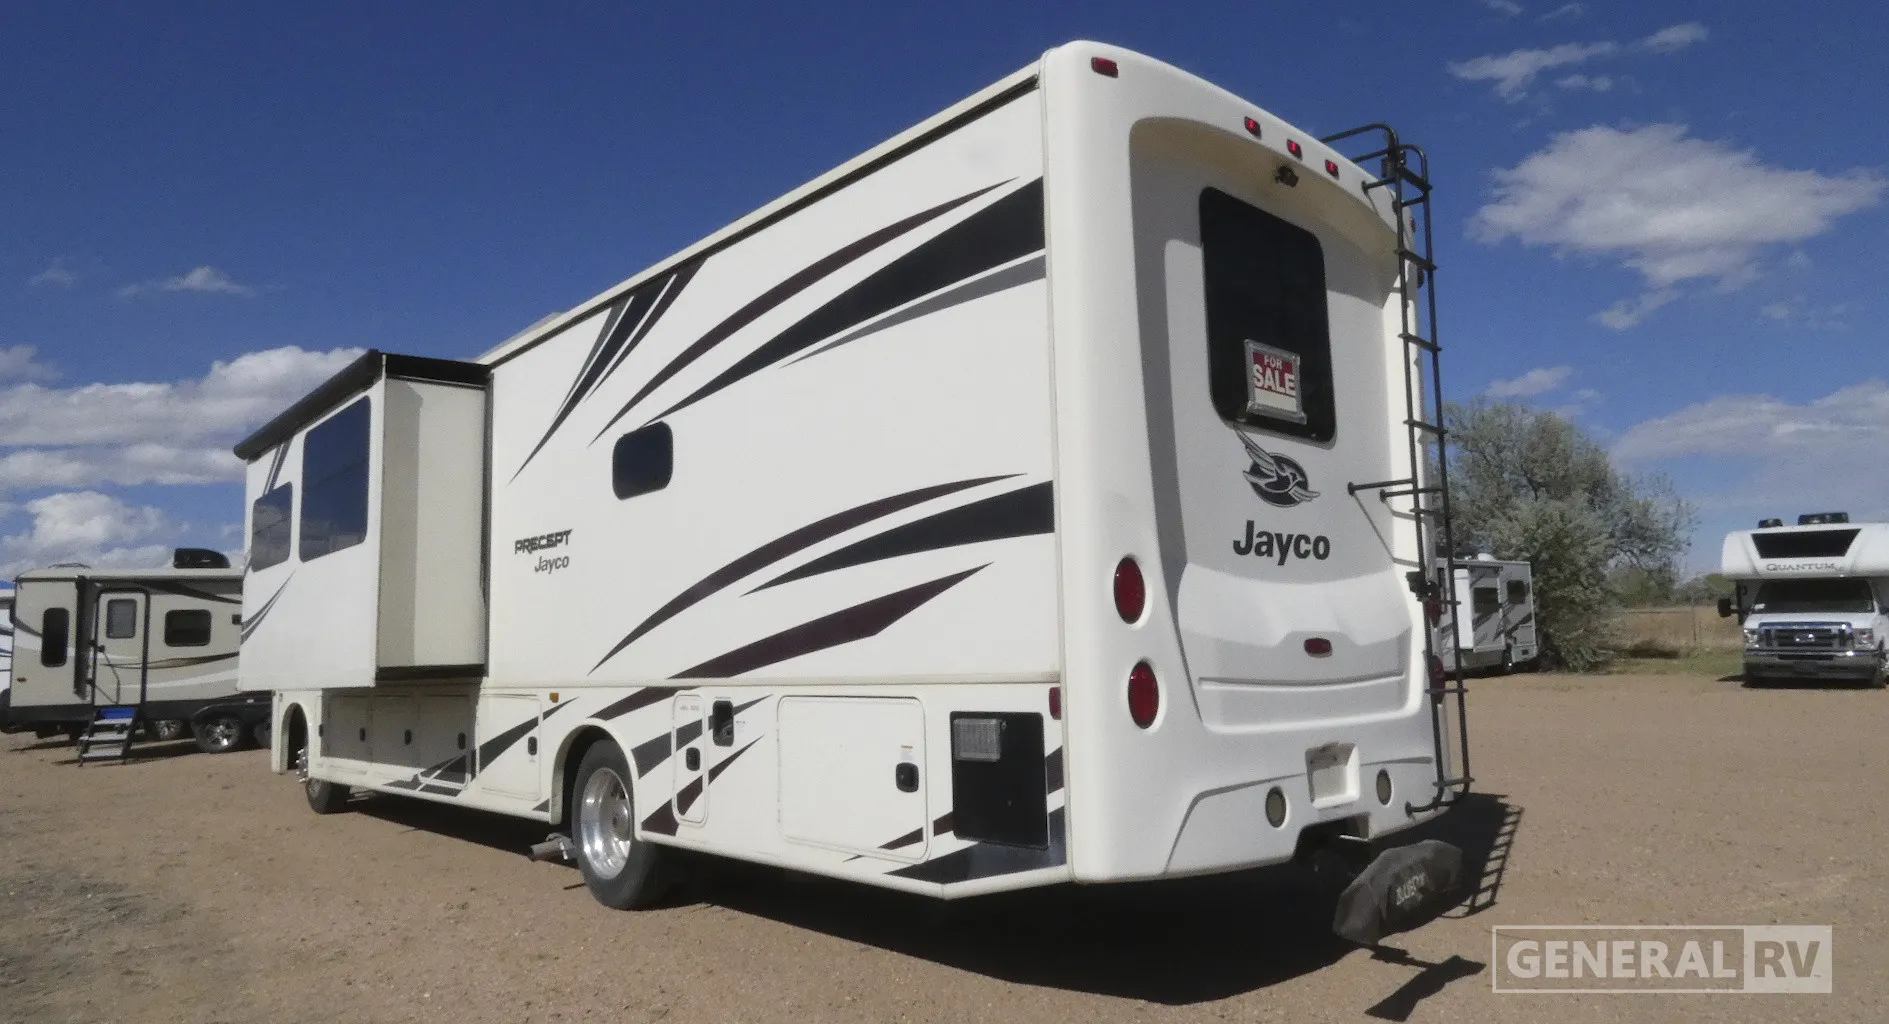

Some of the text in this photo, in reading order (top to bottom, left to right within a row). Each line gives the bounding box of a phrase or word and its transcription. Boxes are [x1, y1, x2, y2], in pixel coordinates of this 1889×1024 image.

[1264, 355, 1283, 370] FOR
[1253, 363, 1296, 397] SALE
[514, 529, 573, 555] PRECEPT
[1233, 520, 1330, 566] Jayco
[534, 556, 570, 575] Jayco
[1766, 563, 1835, 571] QUANTUM
